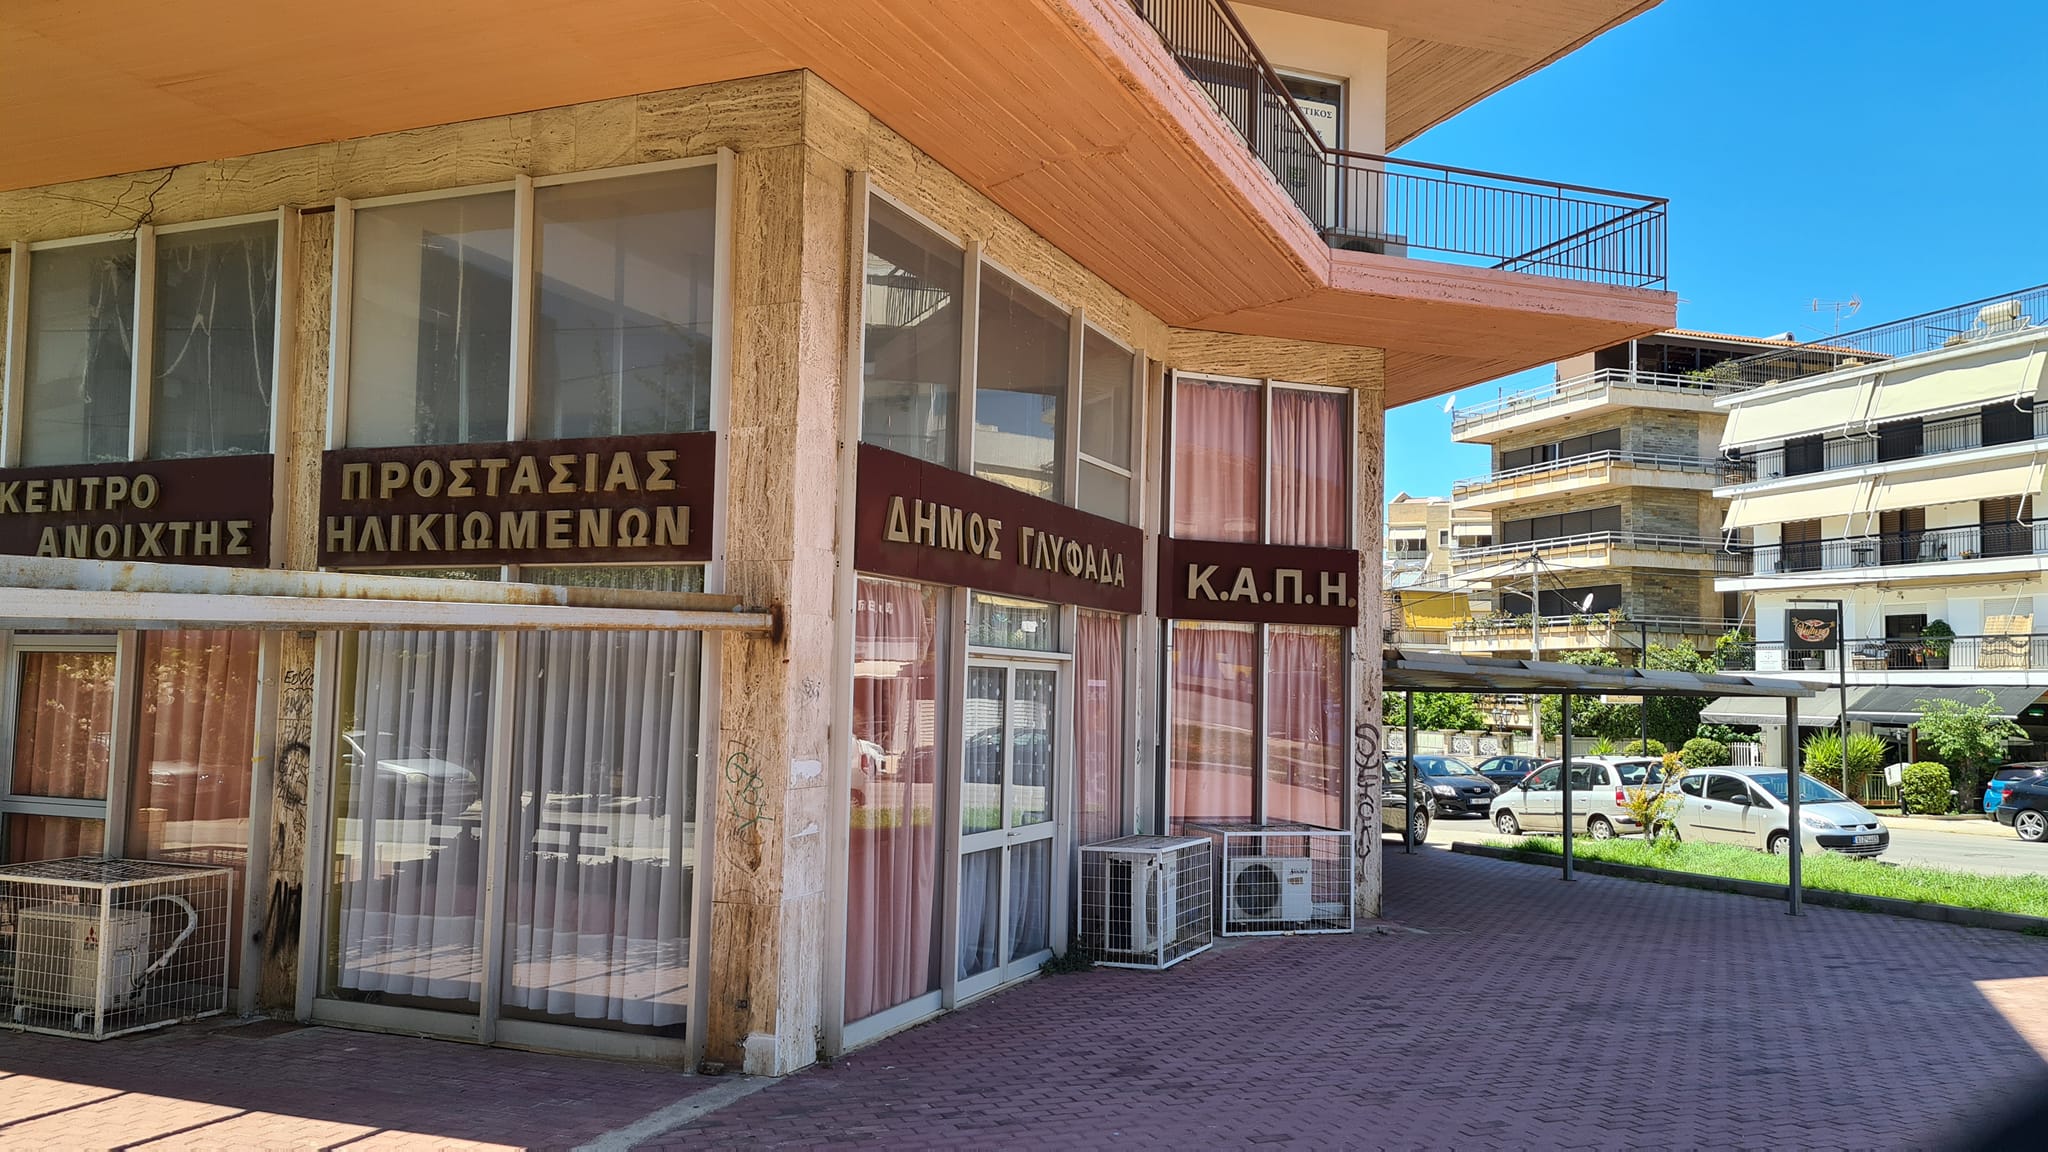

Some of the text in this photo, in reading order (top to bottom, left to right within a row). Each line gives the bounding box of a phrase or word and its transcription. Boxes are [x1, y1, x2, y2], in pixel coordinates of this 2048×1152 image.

[0, 474, 160, 514] ΚΕΝΤΡΟ
[341, 450, 677, 499] ΠΡΟΣΤΑΣΙΑΣ
[36, 520, 253, 558] ΑΝΟΙΧΤΗΣ
[327, 506, 690, 553] ΗΛΙΚΙΩΜΕΝΩΝ
[884, 496, 1125, 588] ΔΗΜΟΣ ΓΛΥΦΑΔΑ
[1187, 563, 1357, 608] Κ.Α.Π.Η.
